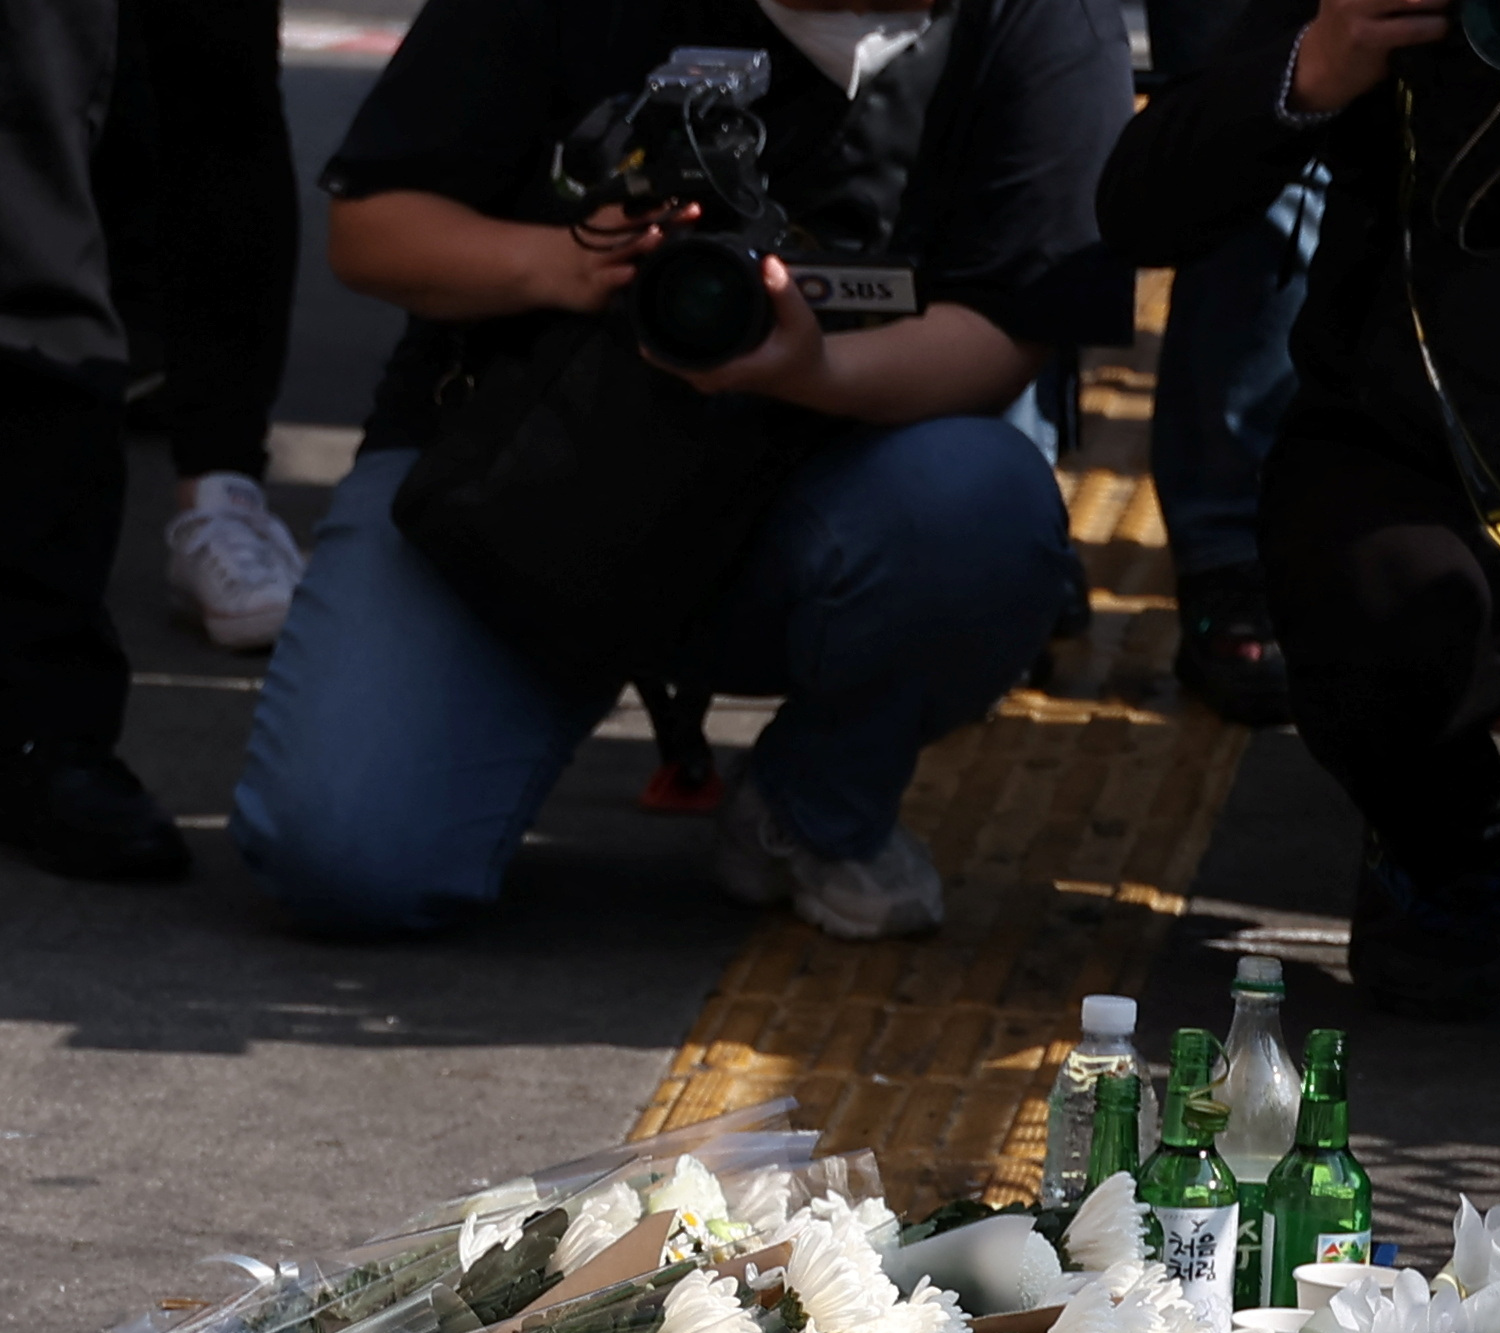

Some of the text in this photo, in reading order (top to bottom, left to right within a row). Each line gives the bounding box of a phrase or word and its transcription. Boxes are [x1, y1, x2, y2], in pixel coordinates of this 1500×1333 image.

[839, 281, 893, 299] SBS
[1167, 1230, 1217, 1258] 처음
[1166, 1258, 1217, 1282] 처럼
